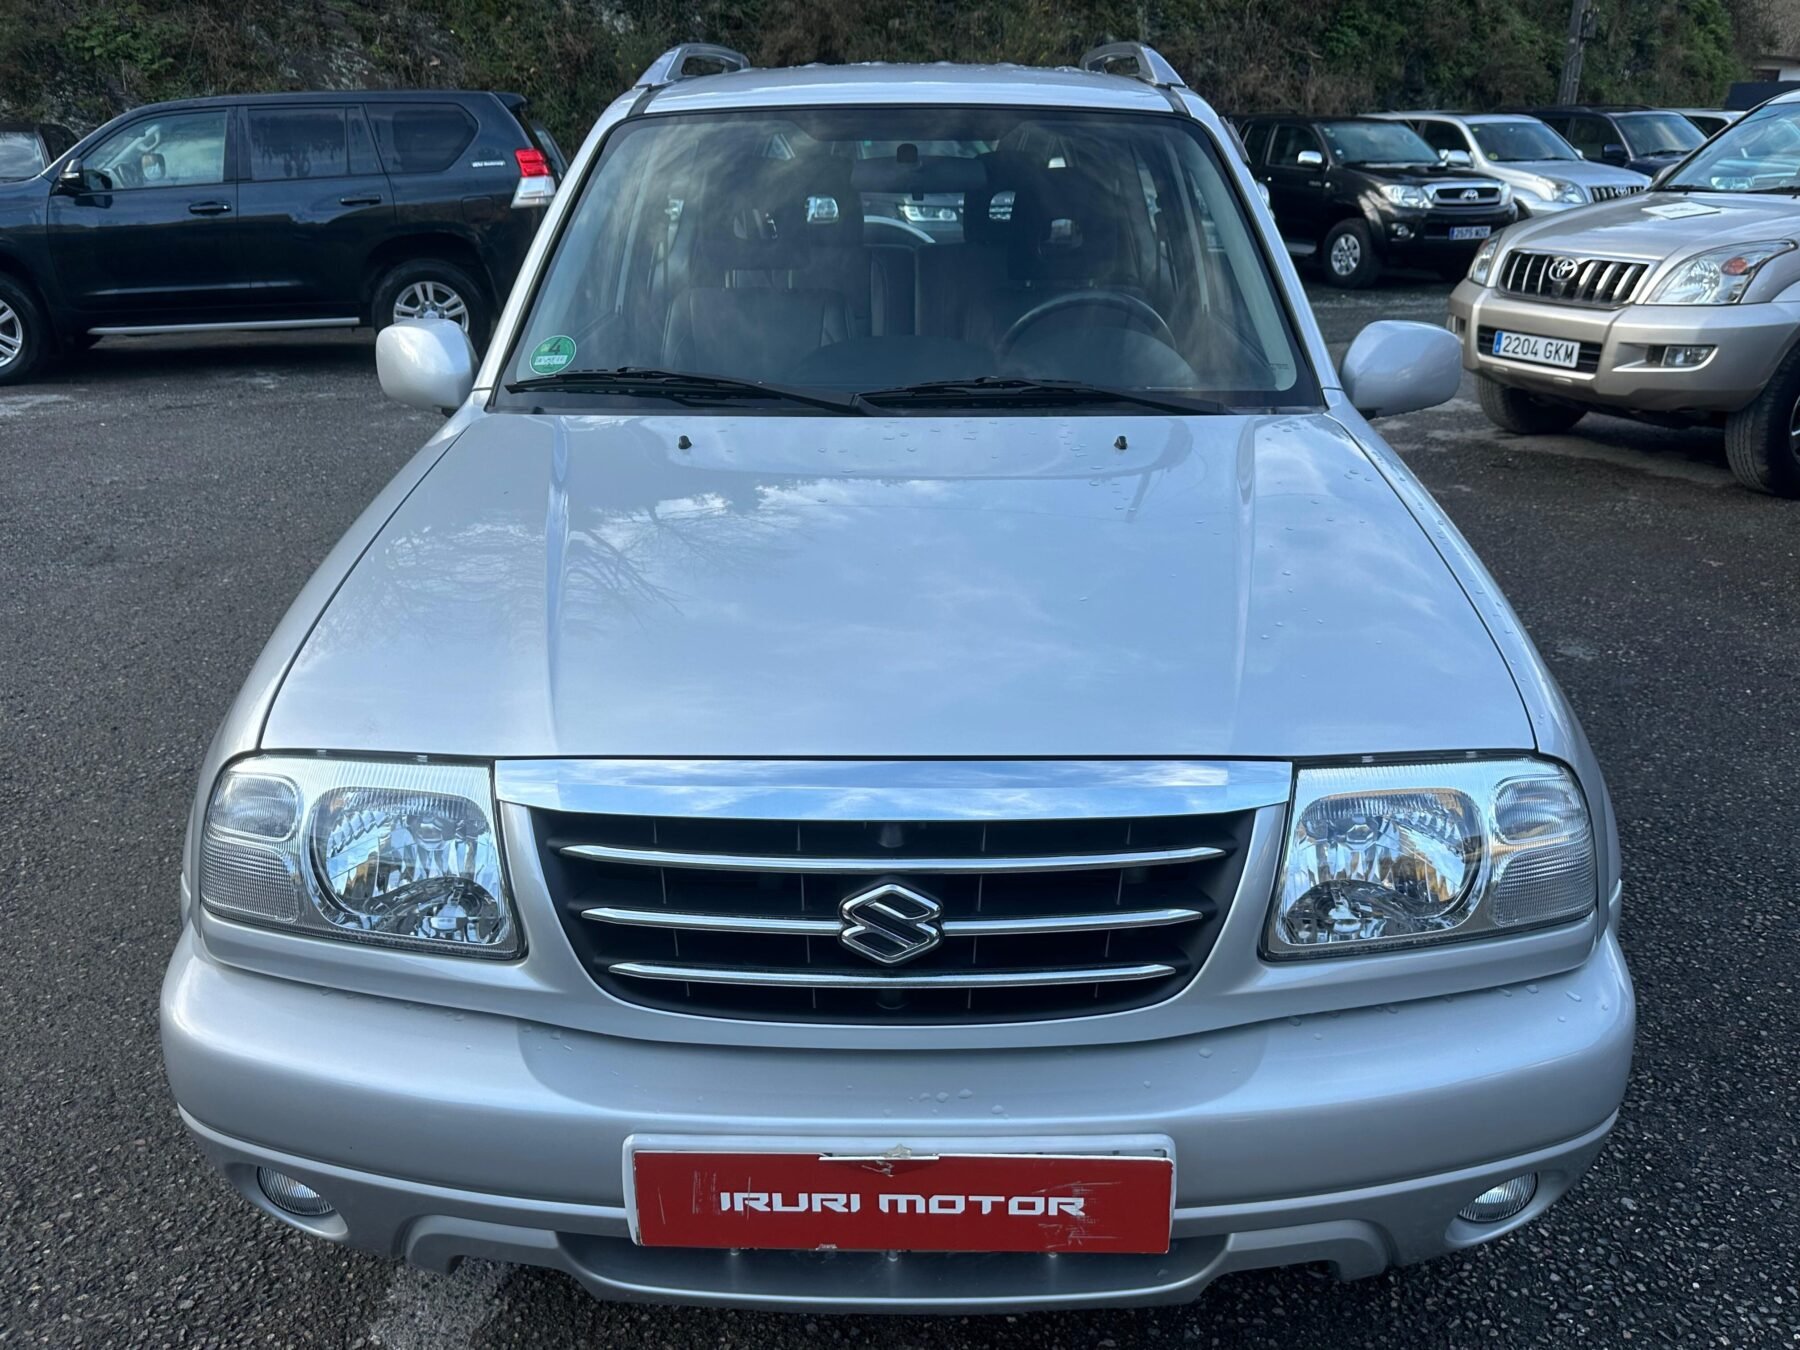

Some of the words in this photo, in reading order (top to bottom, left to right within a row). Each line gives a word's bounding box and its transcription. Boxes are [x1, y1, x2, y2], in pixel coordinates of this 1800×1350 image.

[548, 338, 562, 356] 4
[1503, 335, 1538, 357] 2204
[1544, 342, 1574, 364] GKM
[720, 1192, 861, 1213] IRURI
[878, 1194, 1085, 1216] MOTOR
